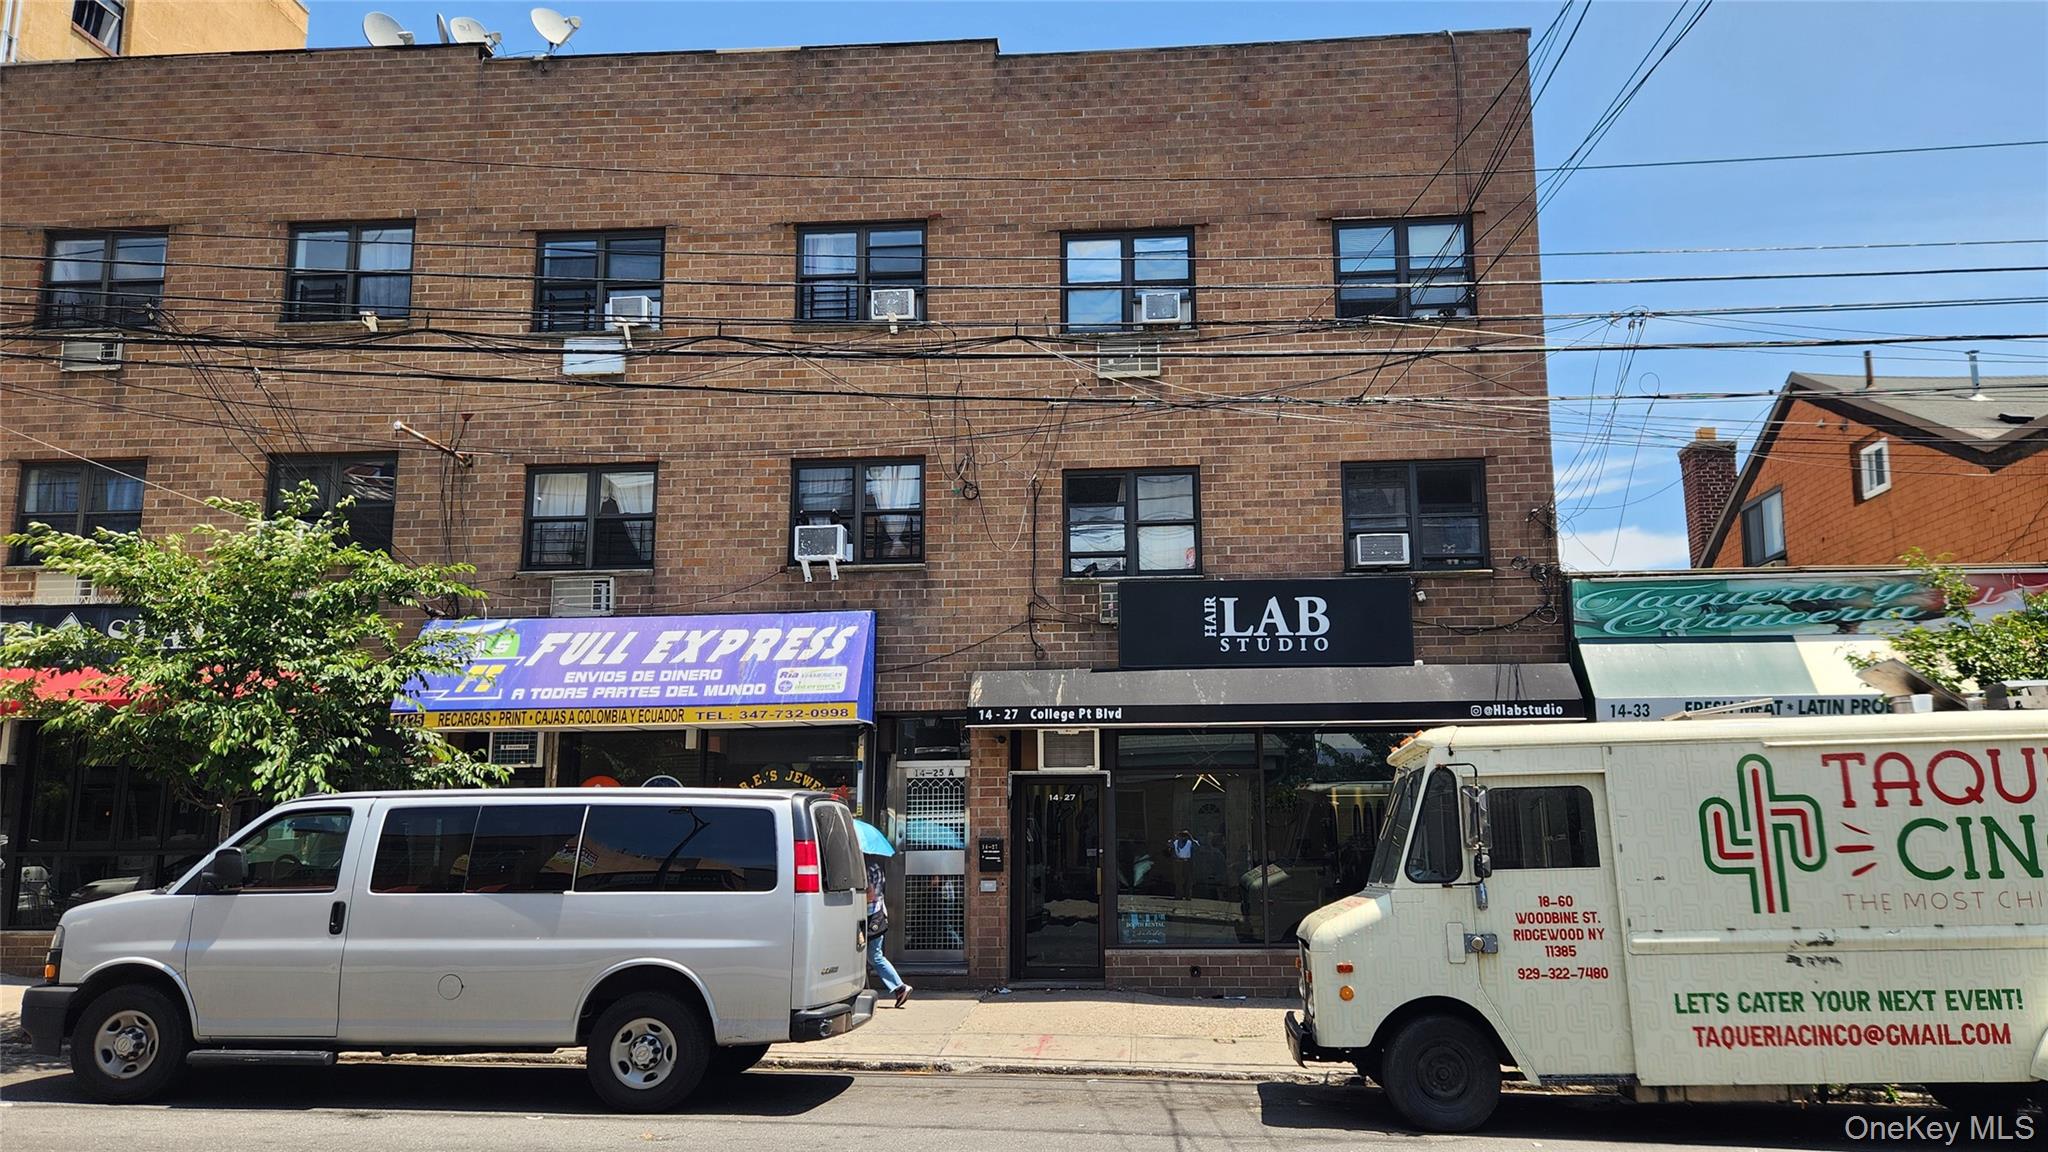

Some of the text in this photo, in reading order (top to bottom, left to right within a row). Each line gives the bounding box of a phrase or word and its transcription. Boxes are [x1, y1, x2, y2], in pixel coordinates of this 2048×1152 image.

[1203, 595, 1217, 637] HAIR
[1219, 595, 1330, 636] LAB
[524, 631, 639, 666] FULL
[641, 626, 859, 664] EXPRESS
[1220, 637, 1329, 651] STUDIO
[564, 669, 723, 684] ENVIOS DE DINERO
[511, 684, 767, 700] A TODAS PARTES DEL MUNDO
[1030, 708, 1075, 722] College
[1078, 708, 1091, 719] Pt
[1095, 707, 1122, 719] Blvd
[1483, 703, 1563, 716] @Hlabstudio
[1610, 703, 1650, 718] 14-33
[1798, 699, 1844, 715] LATIN
[437, 708, 849, 727] RECARGAS PRINT CAJAS A COLOMBIA Y ECUADOR TEL: 347-732-0998
[914, 767, 955, 777] 14-25 A
[1821, 747, 2048, 808] TAQU
[1897, 814, 2048, 880] CIN
[1538, 895, 1573, 907] 18-60
[1841, 893, 1893, 912] THE
[1904, 891, 1985, 910] MOST
[1515, 911, 1601, 924] WOODBINE ST.
[1513, 928, 1605, 941] RIDGEWOOD NY
[1545, 945, 1577, 957] 11385
[1517, 967, 1608, 979] 929-322-7480
[1674, 988, 2024, 1014] LET'S CATER YOUR NEXT EVENT!
[1692, 1022, 2012, 1050] TAQUERIACINCO@GMAIL.COM
